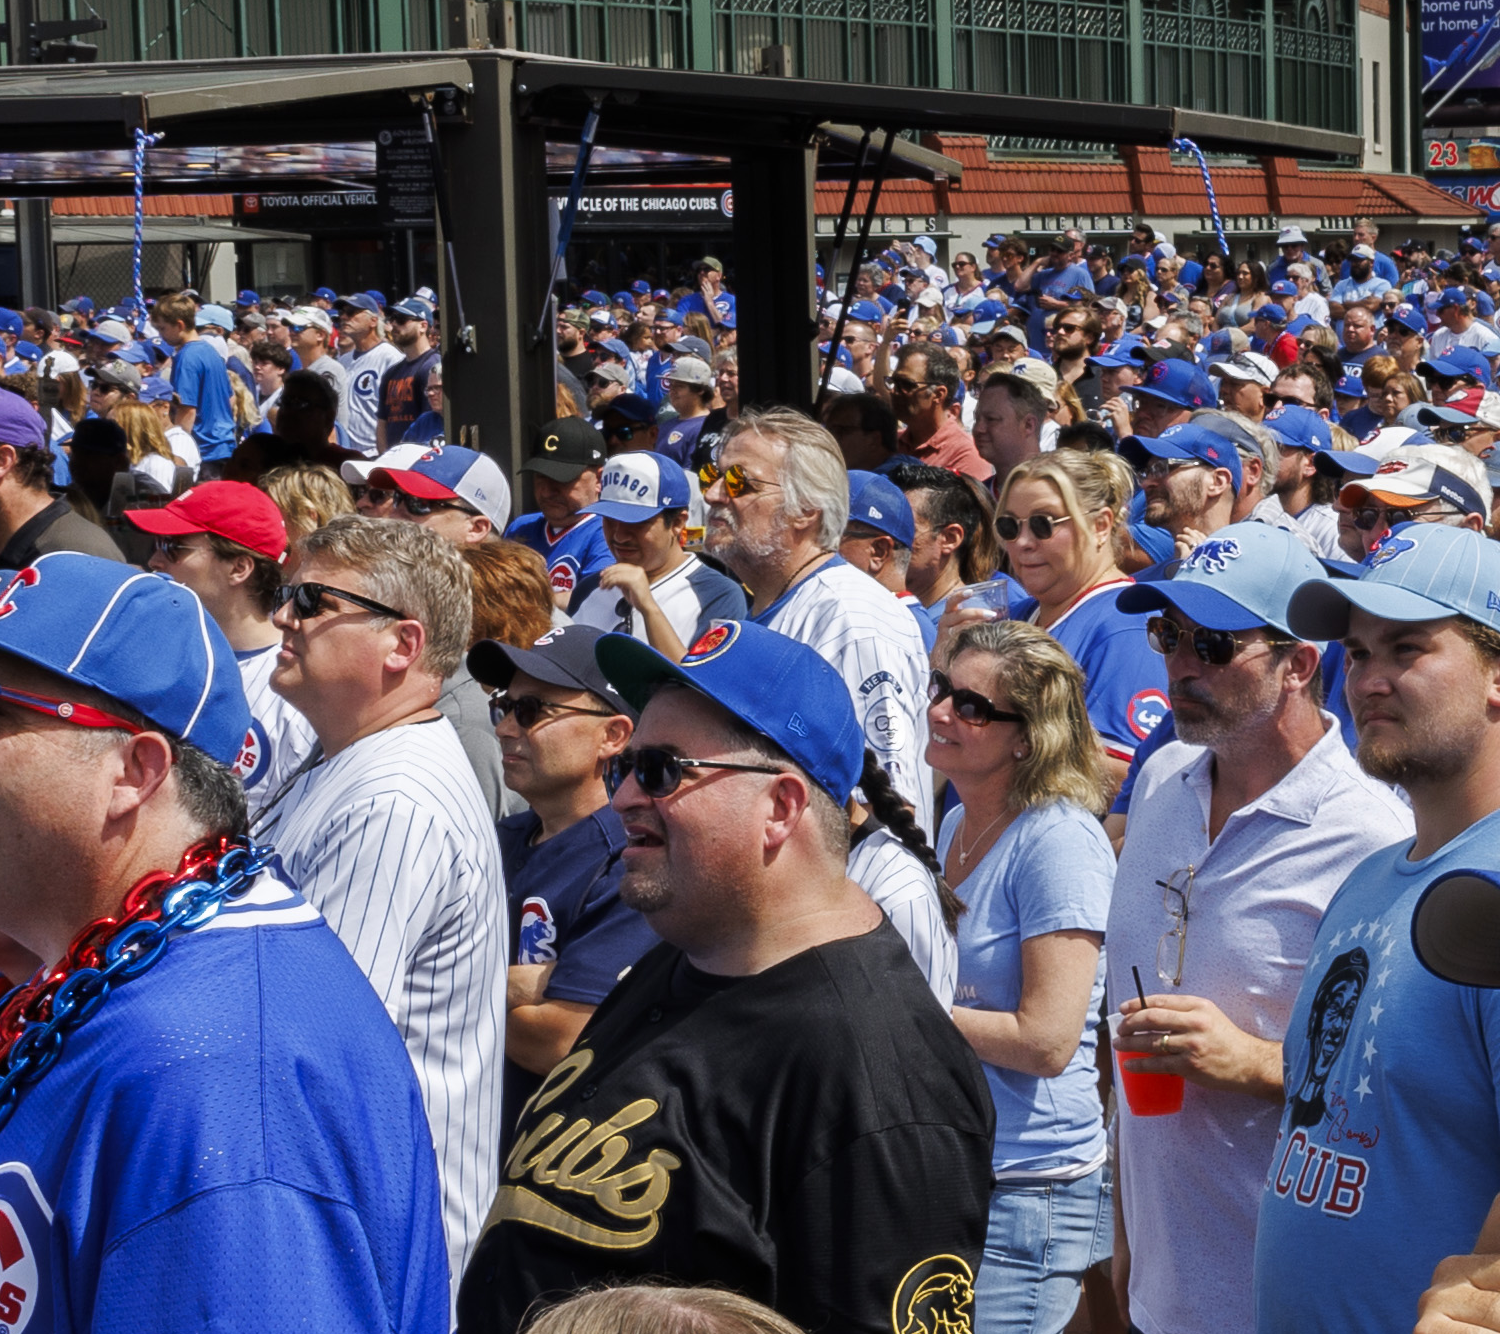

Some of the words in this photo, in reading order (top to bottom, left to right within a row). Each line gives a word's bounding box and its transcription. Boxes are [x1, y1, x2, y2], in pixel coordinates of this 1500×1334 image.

[1421, 0, 1463, 13] home
[1465, 0, 1494, 11] runs
[1438, 17, 1478, 31] home
[1428, 141, 1460, 168] 23
[261, 195, 300, 208] TOYOTA
[301, 194, 343, 207] OFFICIAL
[557, 197, 602, 211] VICLE
[603, 199, 619, 212] OF
[618, 198, 639, 212] THE
[640, 198, 688, 212] CHICAGO
[1027, 215, 1135, 230] TICKETS
[544, 434, 560, 452] C
[602, 471, 649, 498] HICAGO
[863, 673, 886, 691] HEY
[956, 985, 977, 1001] 014
[1274, 1127, 1370, 1219] CUB
